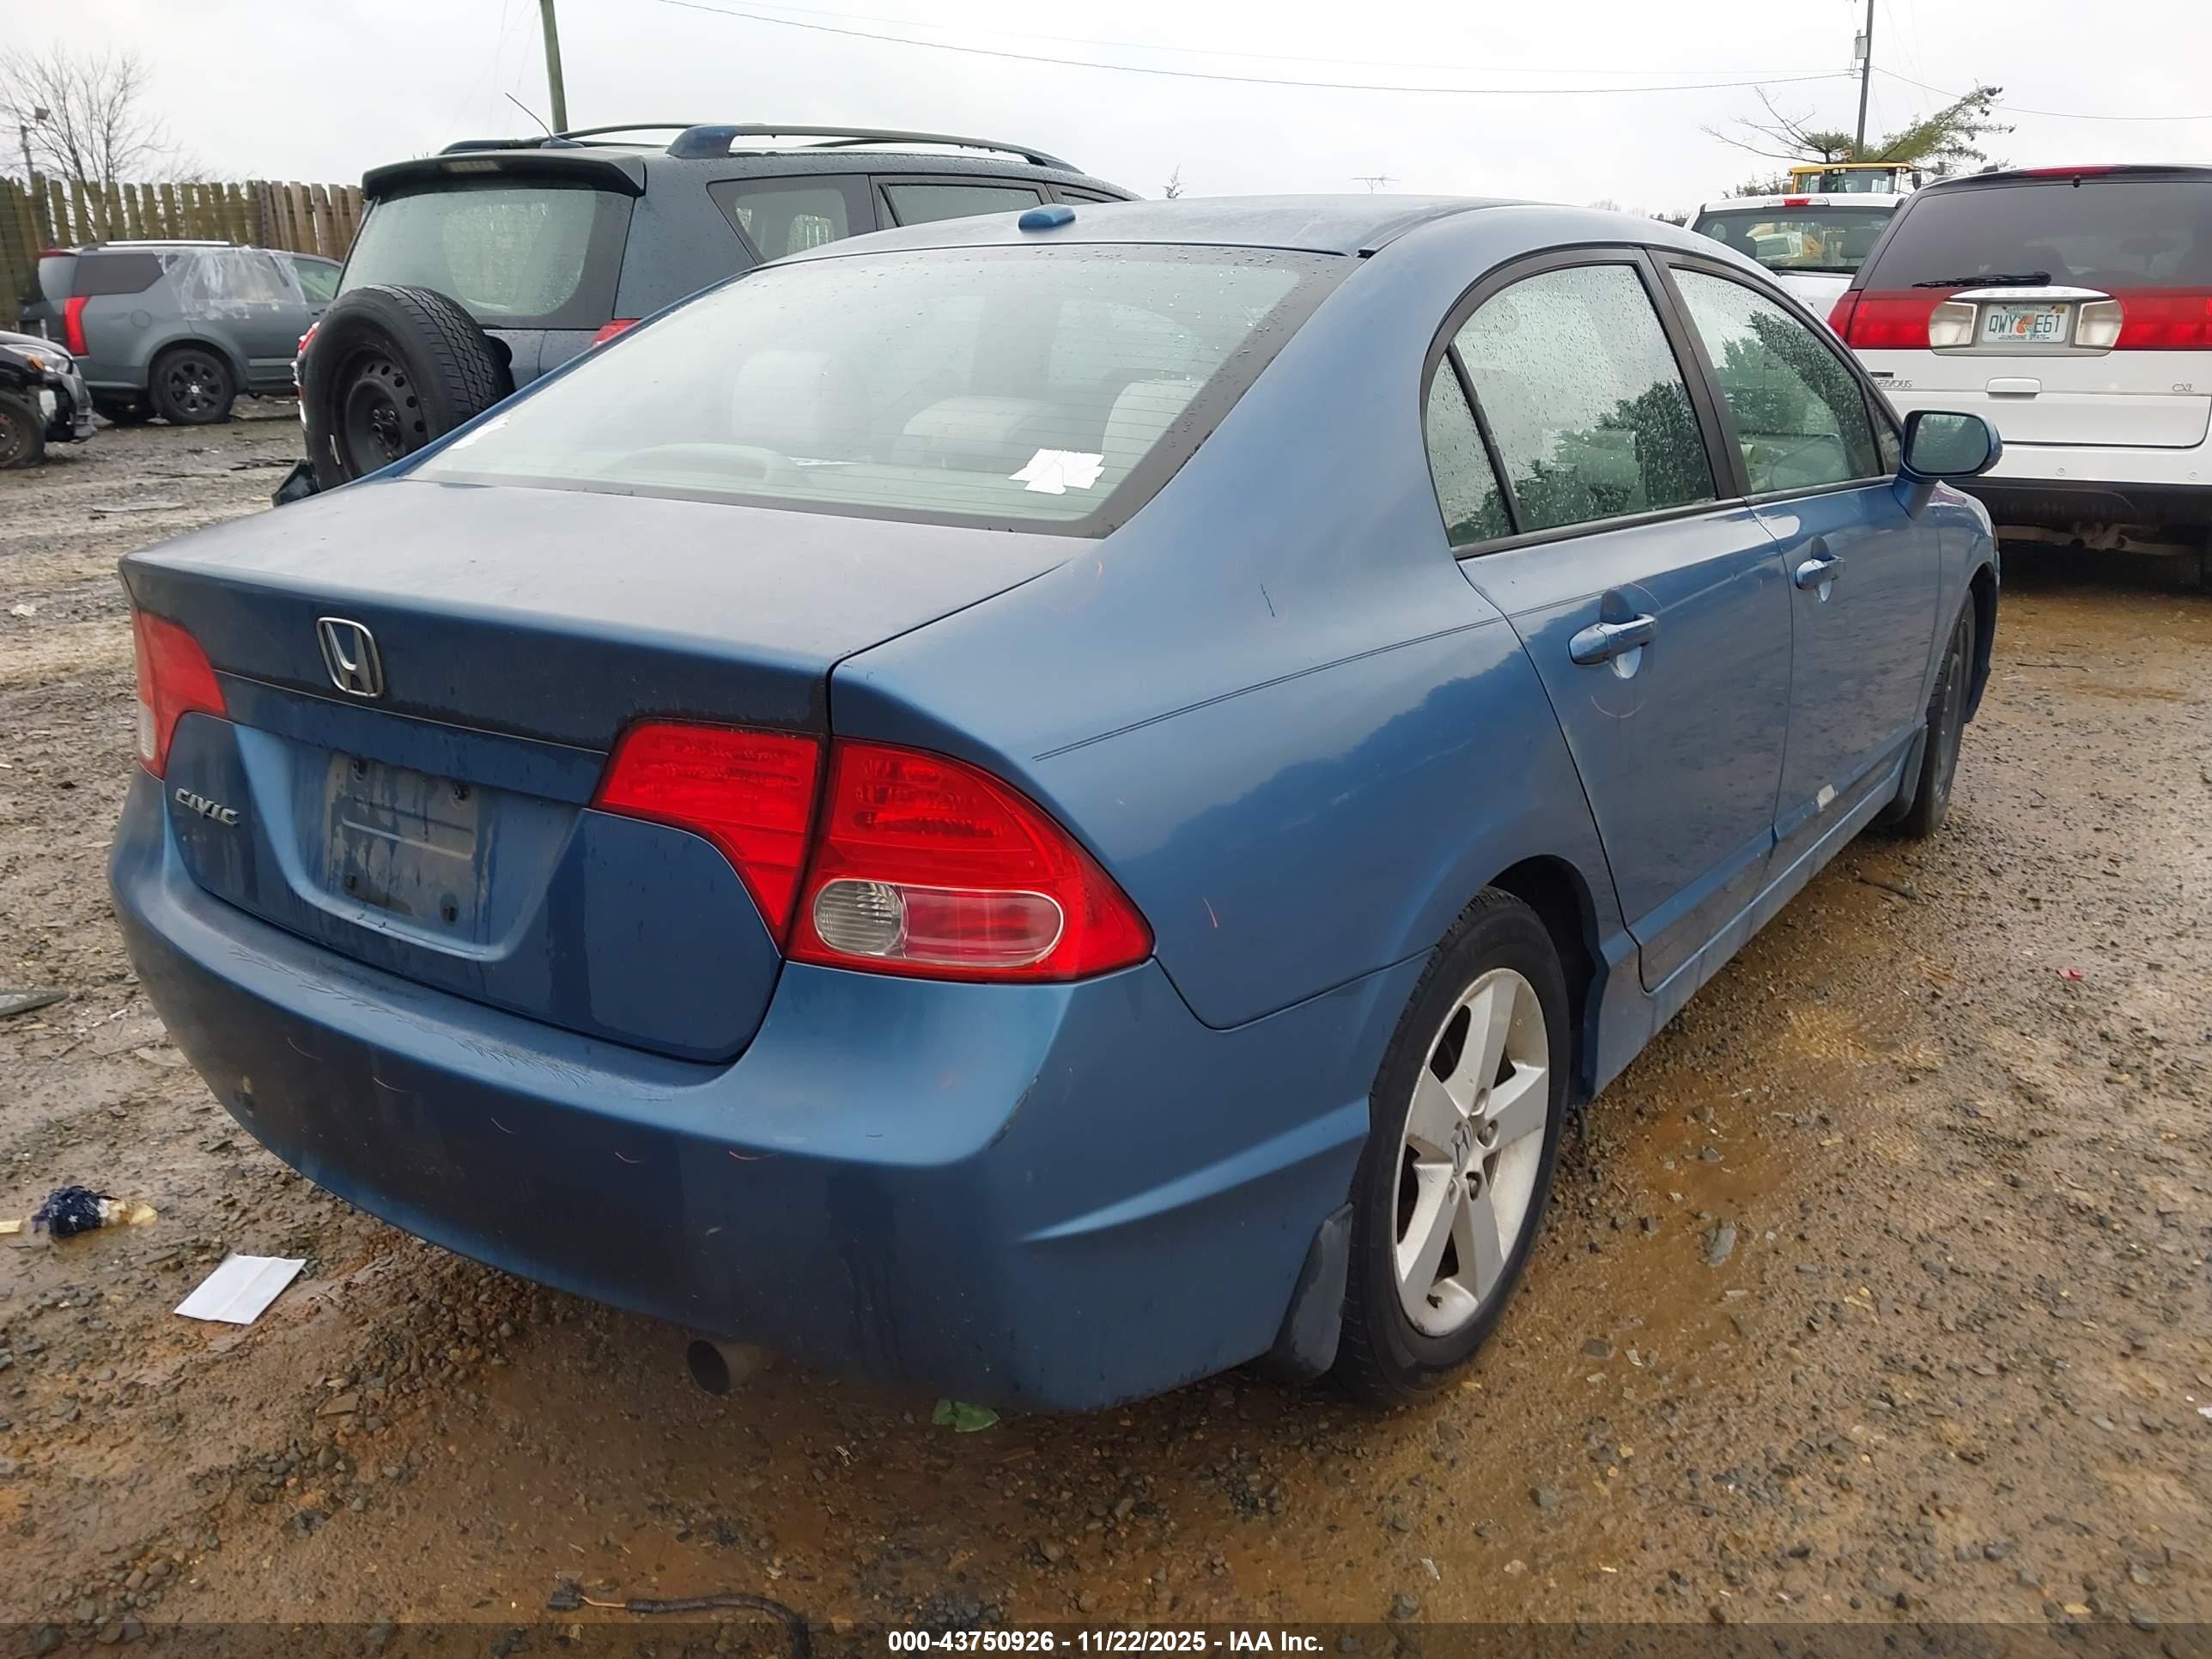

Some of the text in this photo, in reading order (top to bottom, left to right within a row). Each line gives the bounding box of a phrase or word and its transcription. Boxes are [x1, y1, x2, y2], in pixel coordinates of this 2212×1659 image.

[1988, 314, 2061, 333] QWY E61
[2172, 383, 2195, 392] CXL
[175, 787, 240, 825] CIVIC
